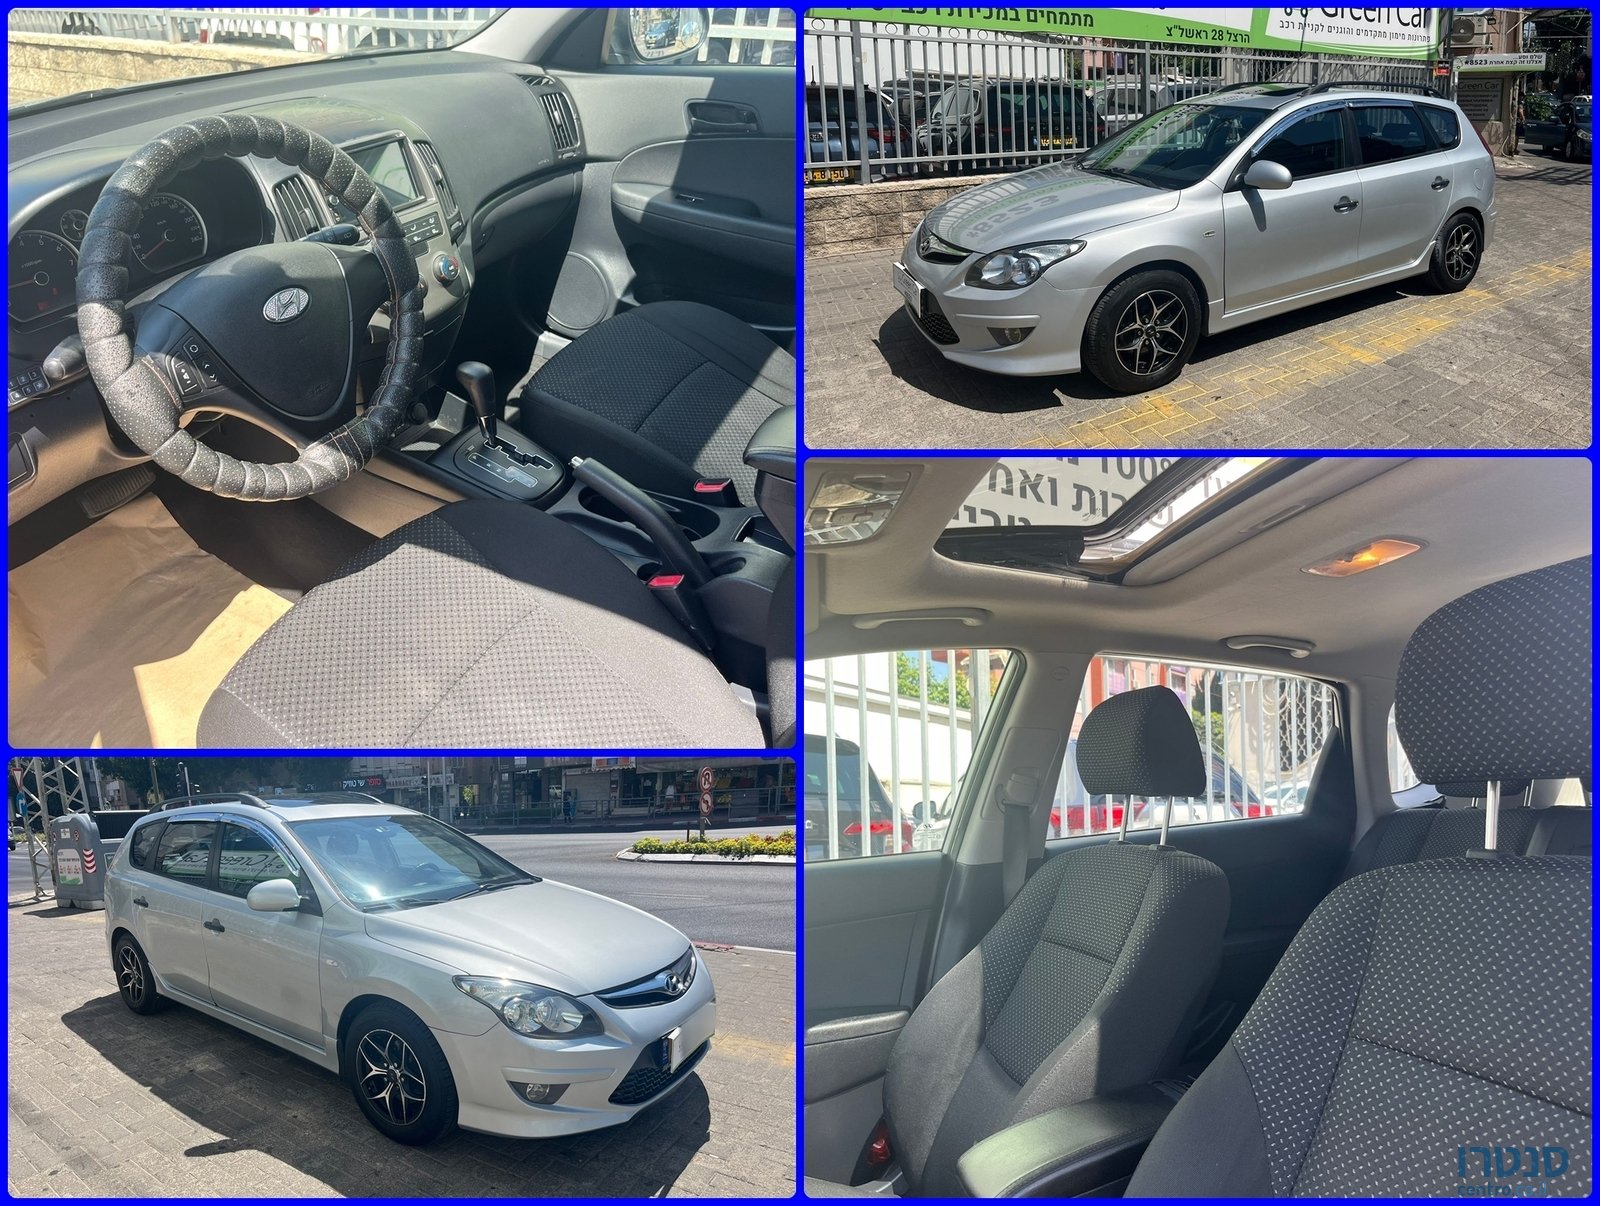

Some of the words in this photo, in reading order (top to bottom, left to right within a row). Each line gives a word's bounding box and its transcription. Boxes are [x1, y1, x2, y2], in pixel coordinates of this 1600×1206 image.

[1026, 8, 1094, 27] מתמחים
[1397, 8, 1431, 28] Car
[1279, 20, 1294, 29] רכב
[1298, 22, 1325, 33] לקניית
[1327, 25, 1353, 34] והוגנים
[1166, 25, 1208, 39] ראשל"צ
[1211, 29, 1224, 41] 28
[1227, 30, 1250, 43] הרצל
[1356, 28, 1387, 39] מתקדמים
[1389, 32, 1406, 40] מימון
[1407, 34, 1431, 42] פתרונות
[1485, 81, 1499, 90] Car
[987, 462, 1058, 507] ואמ
